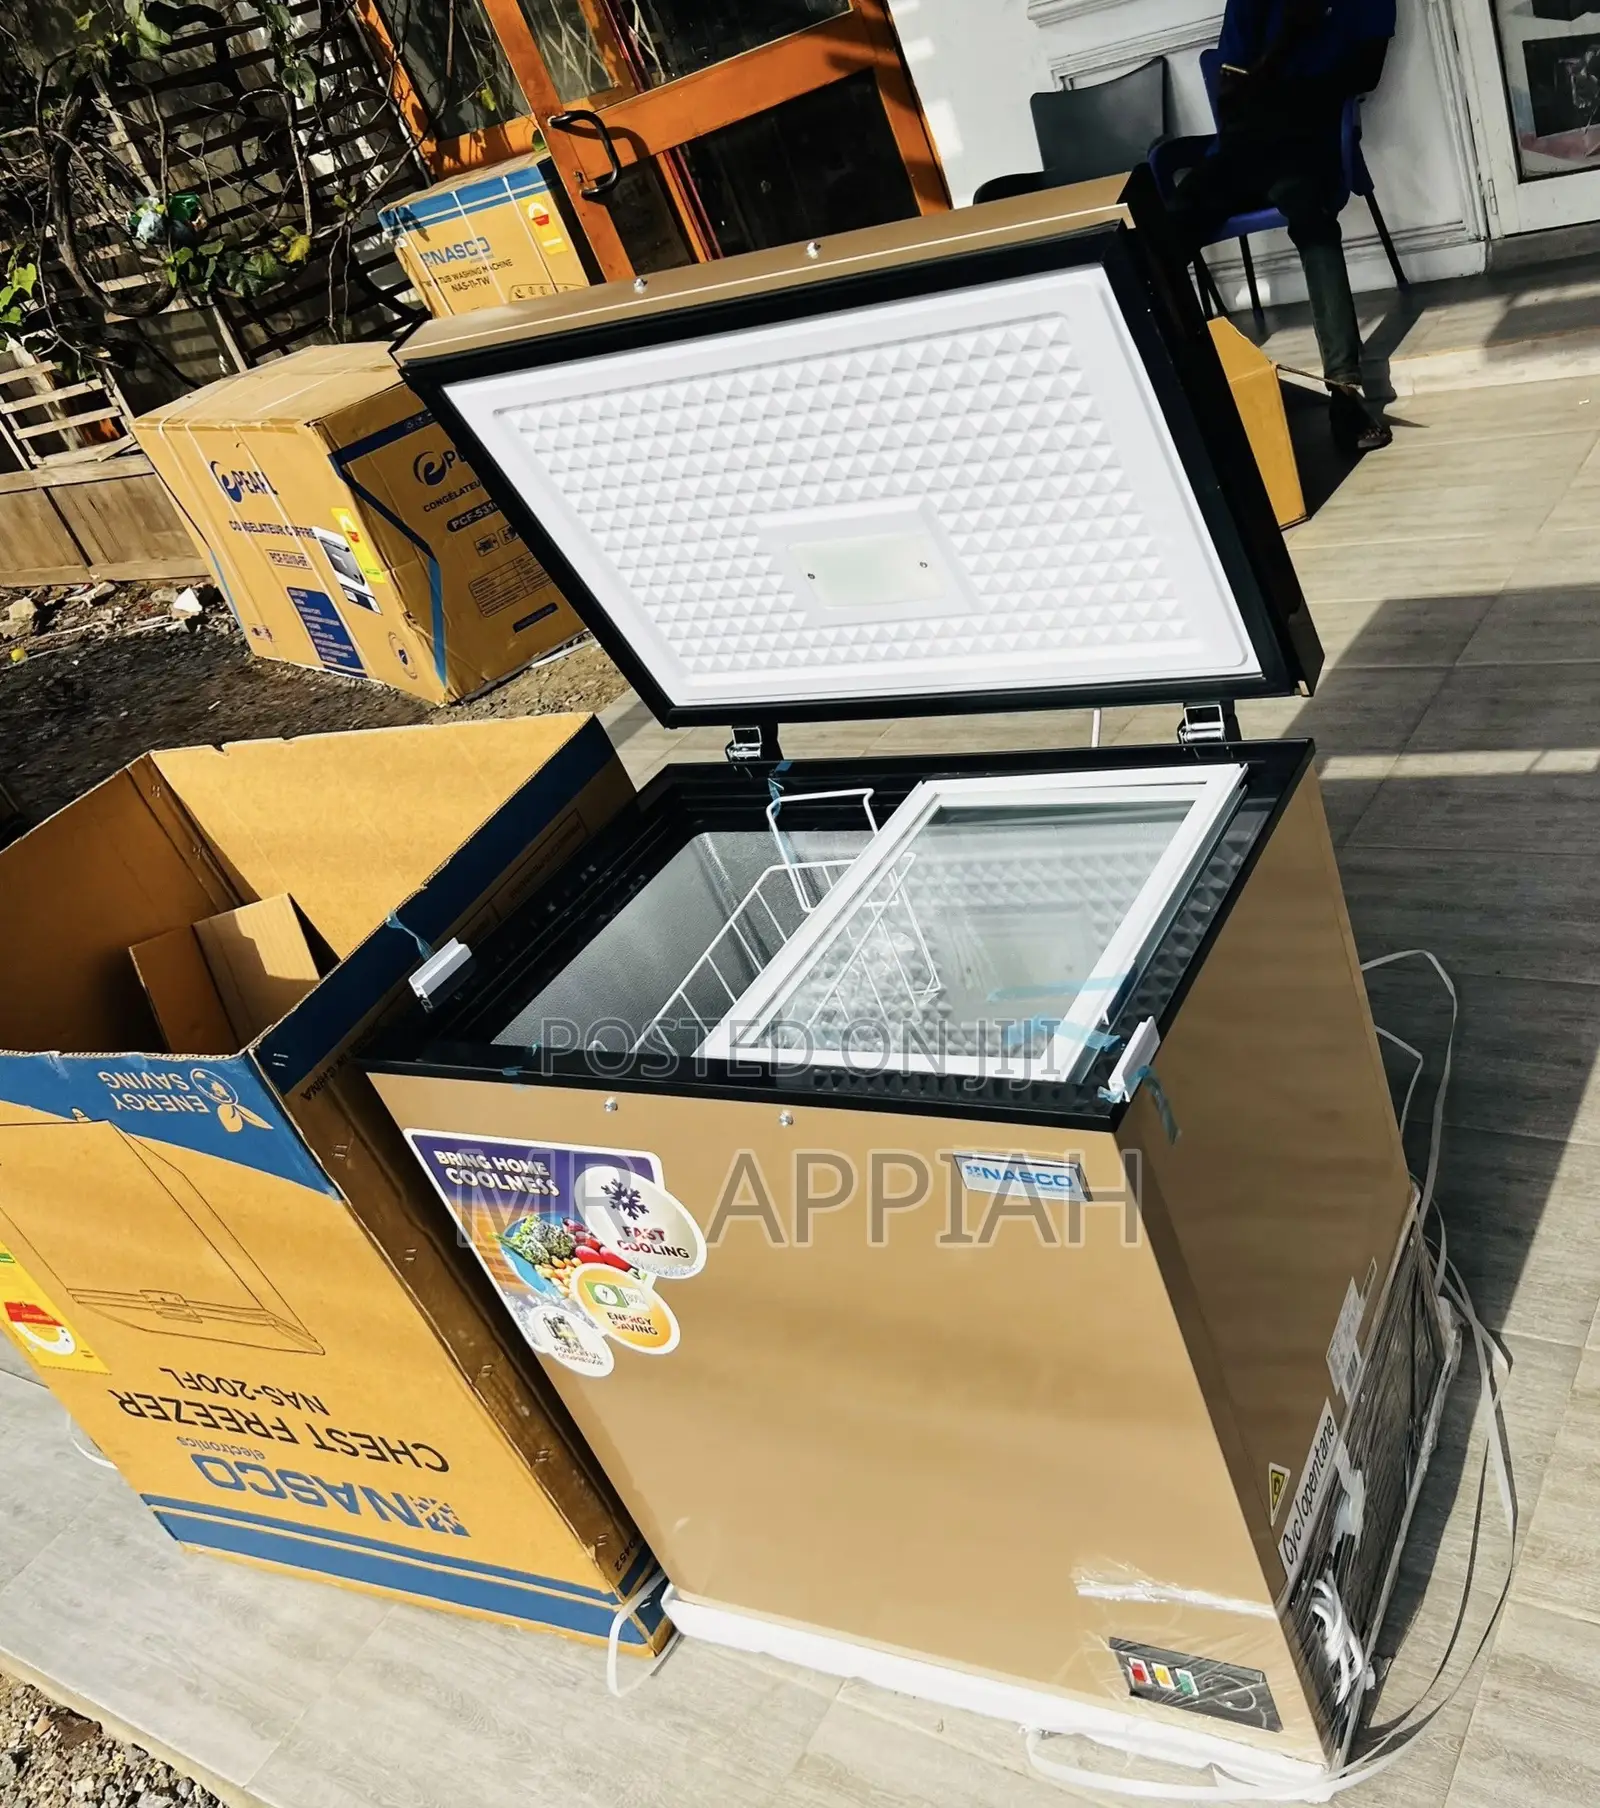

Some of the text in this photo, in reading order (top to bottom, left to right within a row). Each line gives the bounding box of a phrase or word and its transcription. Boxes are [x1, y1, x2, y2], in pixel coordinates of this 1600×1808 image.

[431, 236, 491, 265] NASCO
[452, 264, 487, 282] WASHING
[97, 1071, 190, 1091] SAVING
[110, 1093, 211, 1113] ENERGY
[434, 1150, 550, 1177] BRING HOME
[445, 1167, 560, 1198] COOLNESS
[982, 1167, 1074, 1188] NASCO
[621, 1225, 665, 1242] FAST
[616, 1240, 690, 1259] COOLING
[158, 1366, 331, 1416] NAS-200FL
[107, 1389, 451, 1474] CHEST FREEZER
[176, 1436, 266, 1461] electronics
[190, 1453, 425, 1530] NASCO
[1281, 1415, 1335, 1566] Cyclopentane
